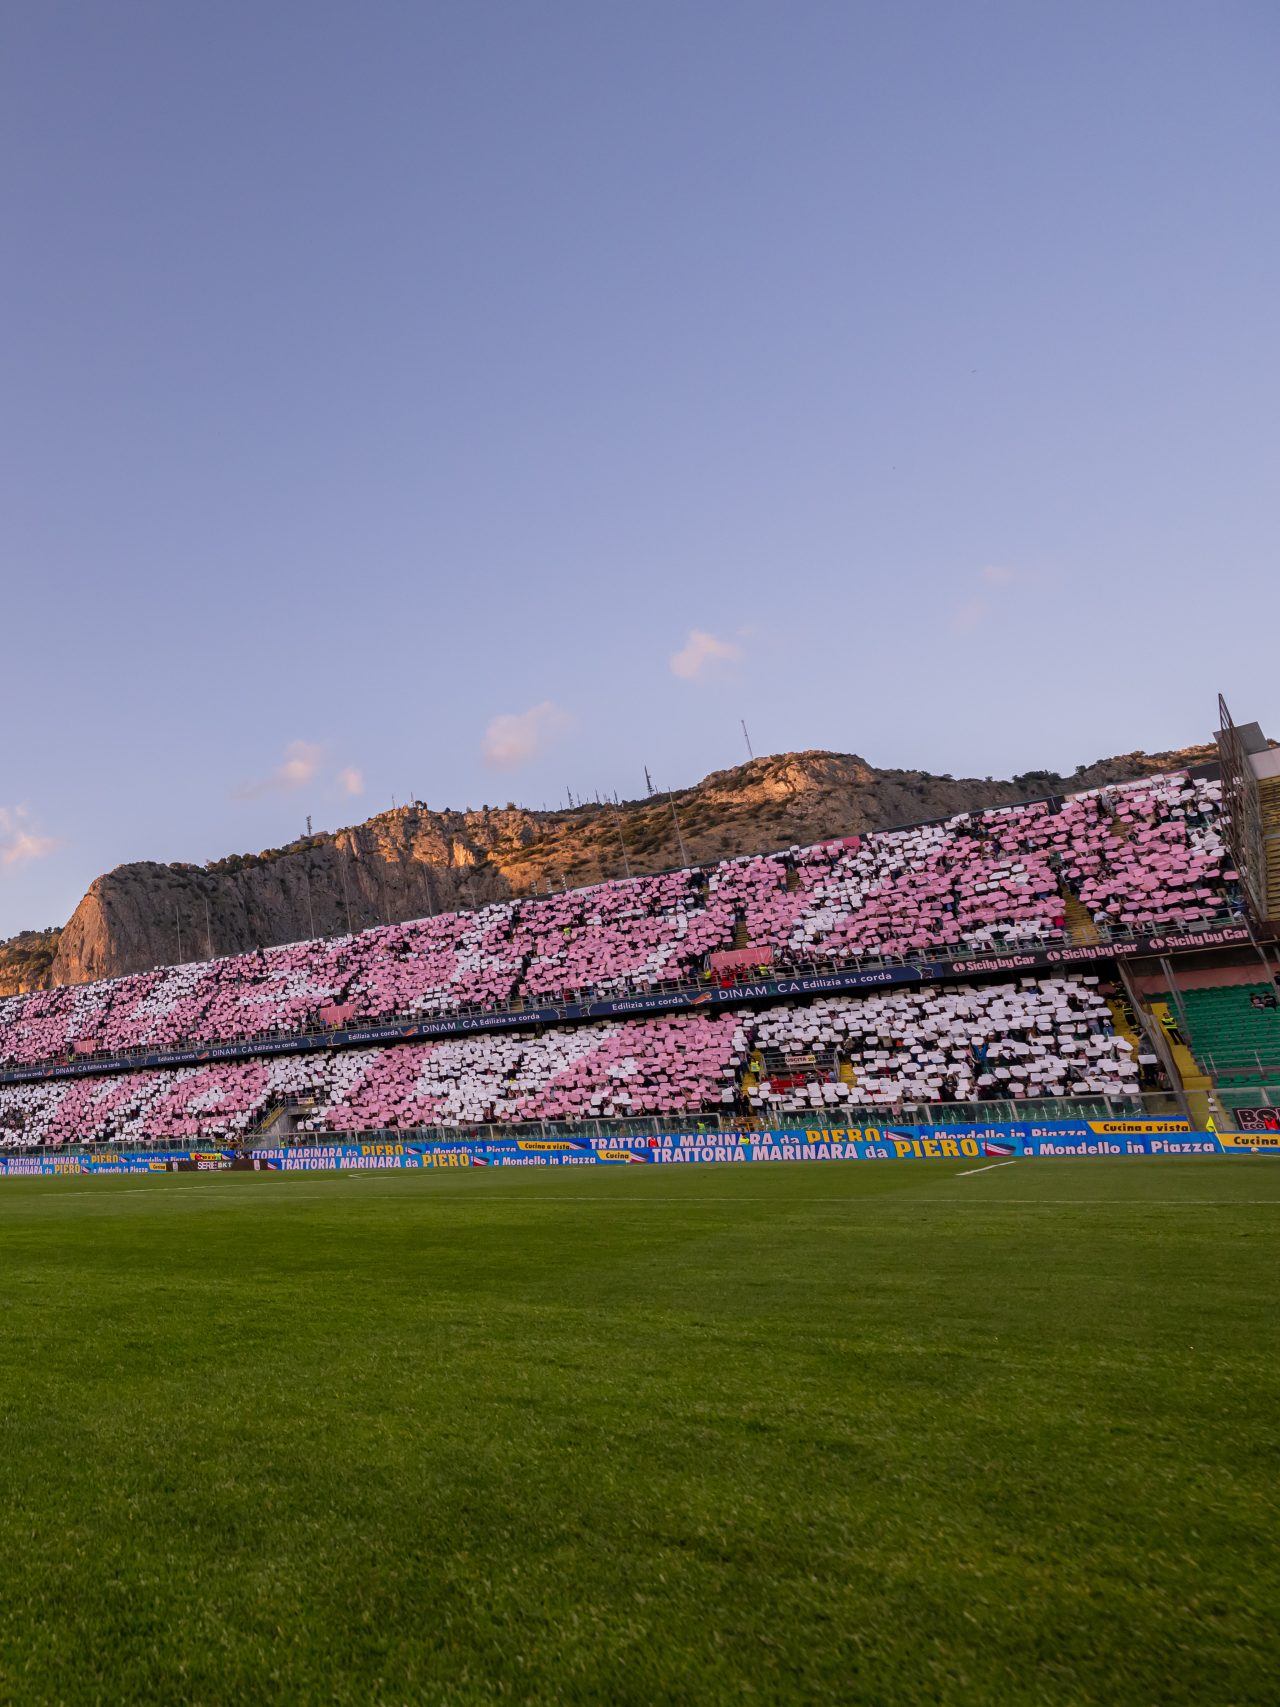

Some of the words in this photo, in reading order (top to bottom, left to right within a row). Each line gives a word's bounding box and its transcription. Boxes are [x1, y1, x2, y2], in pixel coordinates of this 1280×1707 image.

[802, 976, 842, 989] Edilizia
[844, 976, 857, 985] su
[860, 971, 892, 983] corda
[611, 1000, 643, 1011] Edilizia
[644, 999, 656, 1008] su
[657, 995, 684, 1006] corda
[479, 1017, 506, 1026] Edilizia
[518, 1012, 540, 1021] corda
[348, 1032, 370, 1041] Edilizia
[380, 1028, 399, 1037] corda
[1103, 1123, 1142, 1132] Cucina
[1156, 1123, 1189, 1132] vista
[805, 1128, 881, 1143] PIERO
[1234, 1136, 1279, 1145] Cucina
[361, 1145, 404, 1156] PIERO
[525, 1142, 546, 1150] Cucina
[652, 1147, 746, 1163] TRATTORIA
[752, 1143, 859, 1161] MARINARA
[865, 1145, 889, 1159] da
[893, 1138, 980, 1158] PIERO
[1023, 1146, 1033, 1156] a
[1039, 1141, 1121, 1156] Mondello
[1126, 1140, 1144, 1154] in
[1150, 1139, 1215, 1154] Piazza
[280, 1157, 337, 1170] TRATTORIA
[339, 1156, 402, 1169] MARINARA
[405, 1157, 418, 1168] da
[422, 1153, 470, 1168] PIERO
[502, 1155, 547, 1166] Mondello
[550, 1155, 559, 1165] in
[563, 1154, 596, 1165] Piazza
[605, 1152, 629, 1160] Cucina
[54, 1163, 81, 1174] PIERO
[197, 1161, 218, 1170] SERIE
